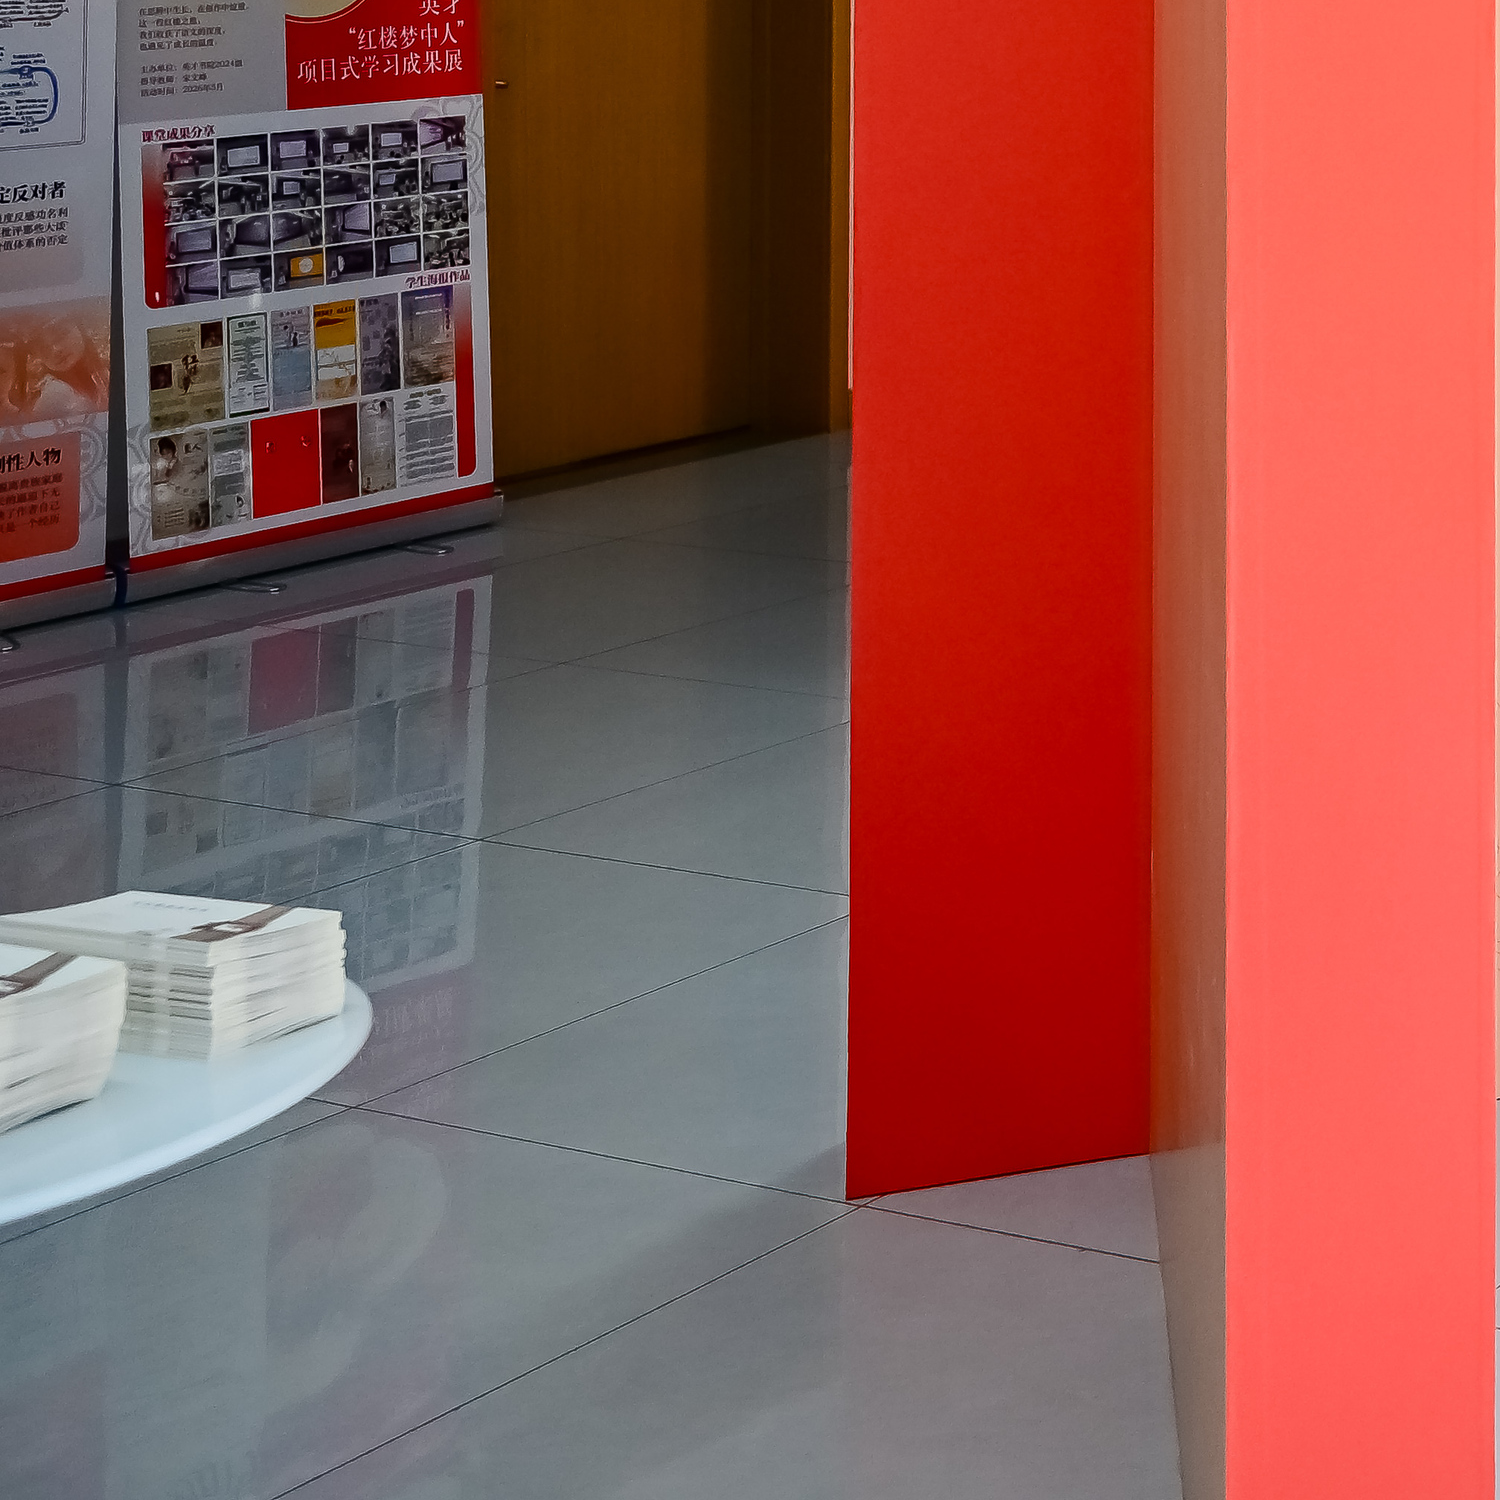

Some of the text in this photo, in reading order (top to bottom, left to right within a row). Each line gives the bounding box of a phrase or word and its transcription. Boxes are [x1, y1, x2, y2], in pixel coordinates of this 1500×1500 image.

[297, 49, 463, 83] 项目式学习成果展
[0, 207, 68, 223] 度反感功名利
[0, 234, 68, 251] 值体系的否定
